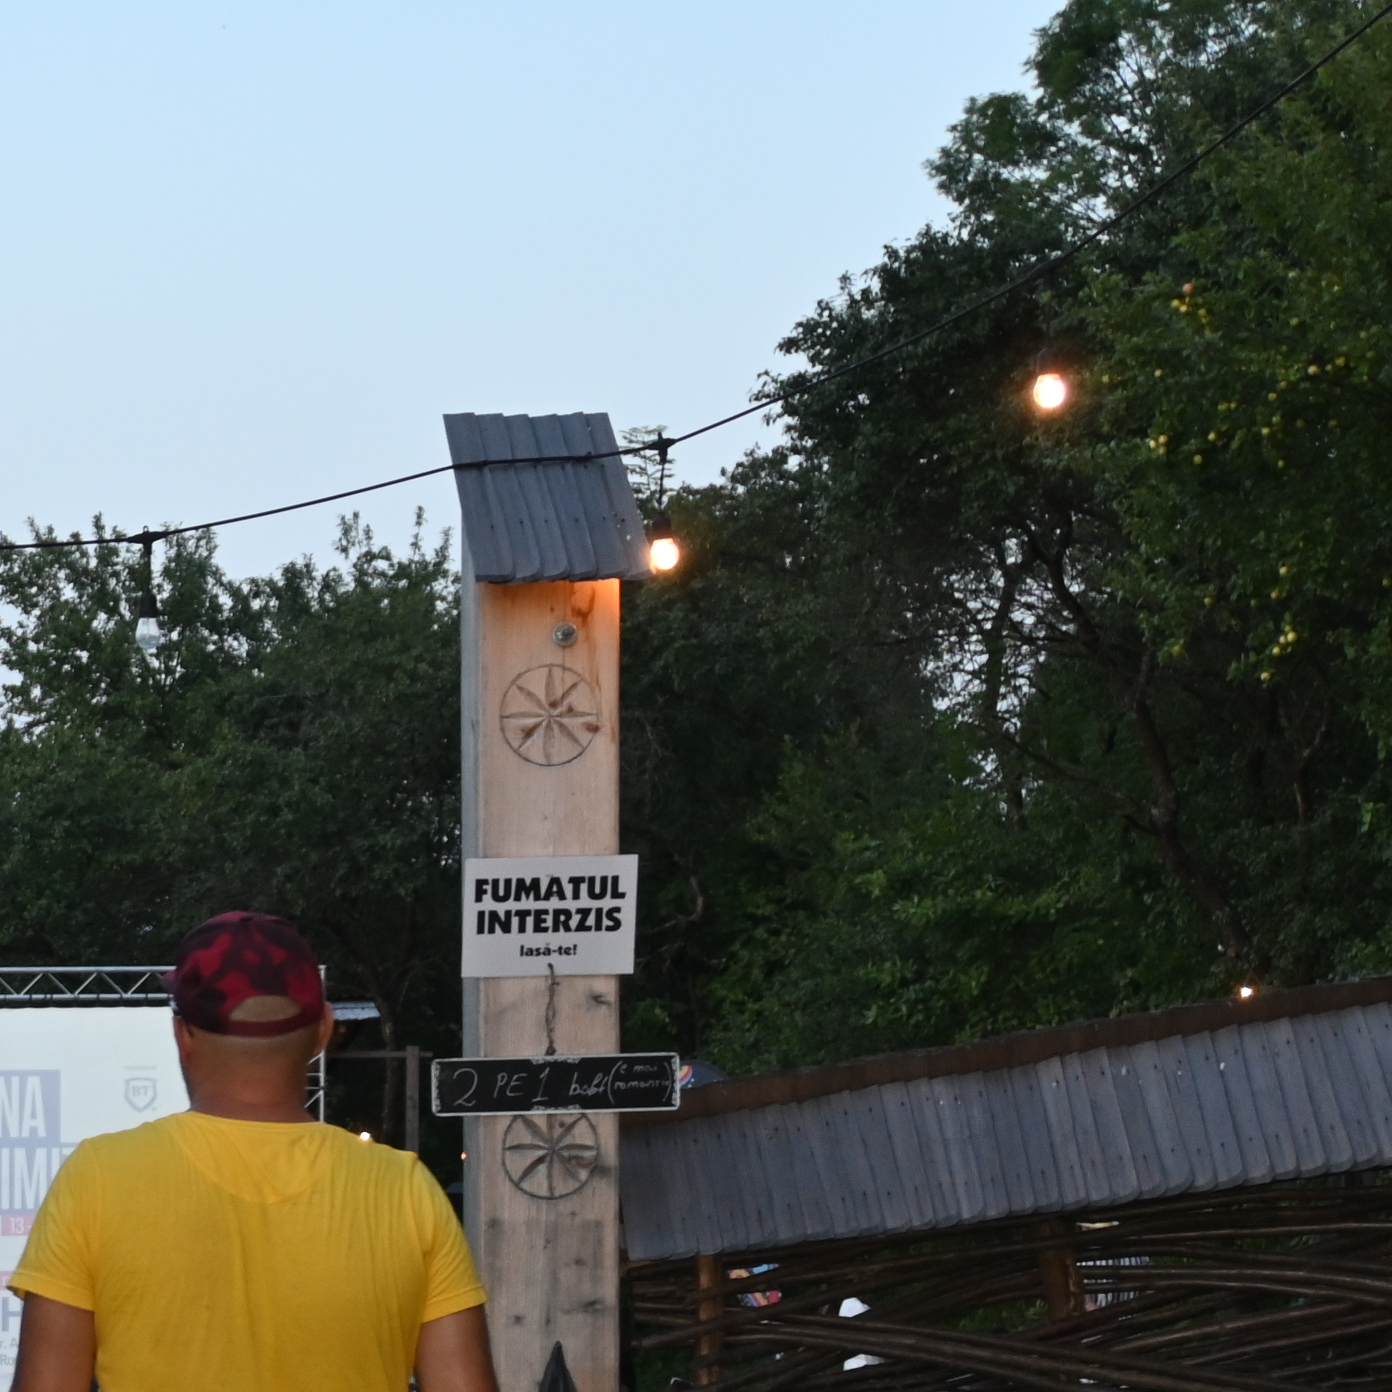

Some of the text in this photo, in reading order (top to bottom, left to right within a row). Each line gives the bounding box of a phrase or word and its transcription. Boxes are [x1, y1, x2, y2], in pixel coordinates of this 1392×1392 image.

[475, 875, 626, 903] FUMATUL
[476, 907, 622, 935] INTERZIS
[453, 1068, 478, 1107] 2
[493, 1073, 527, 1098] PE
[532, 1067, 550, 1103] 1
[10, 1216, 25, 1234] 13
